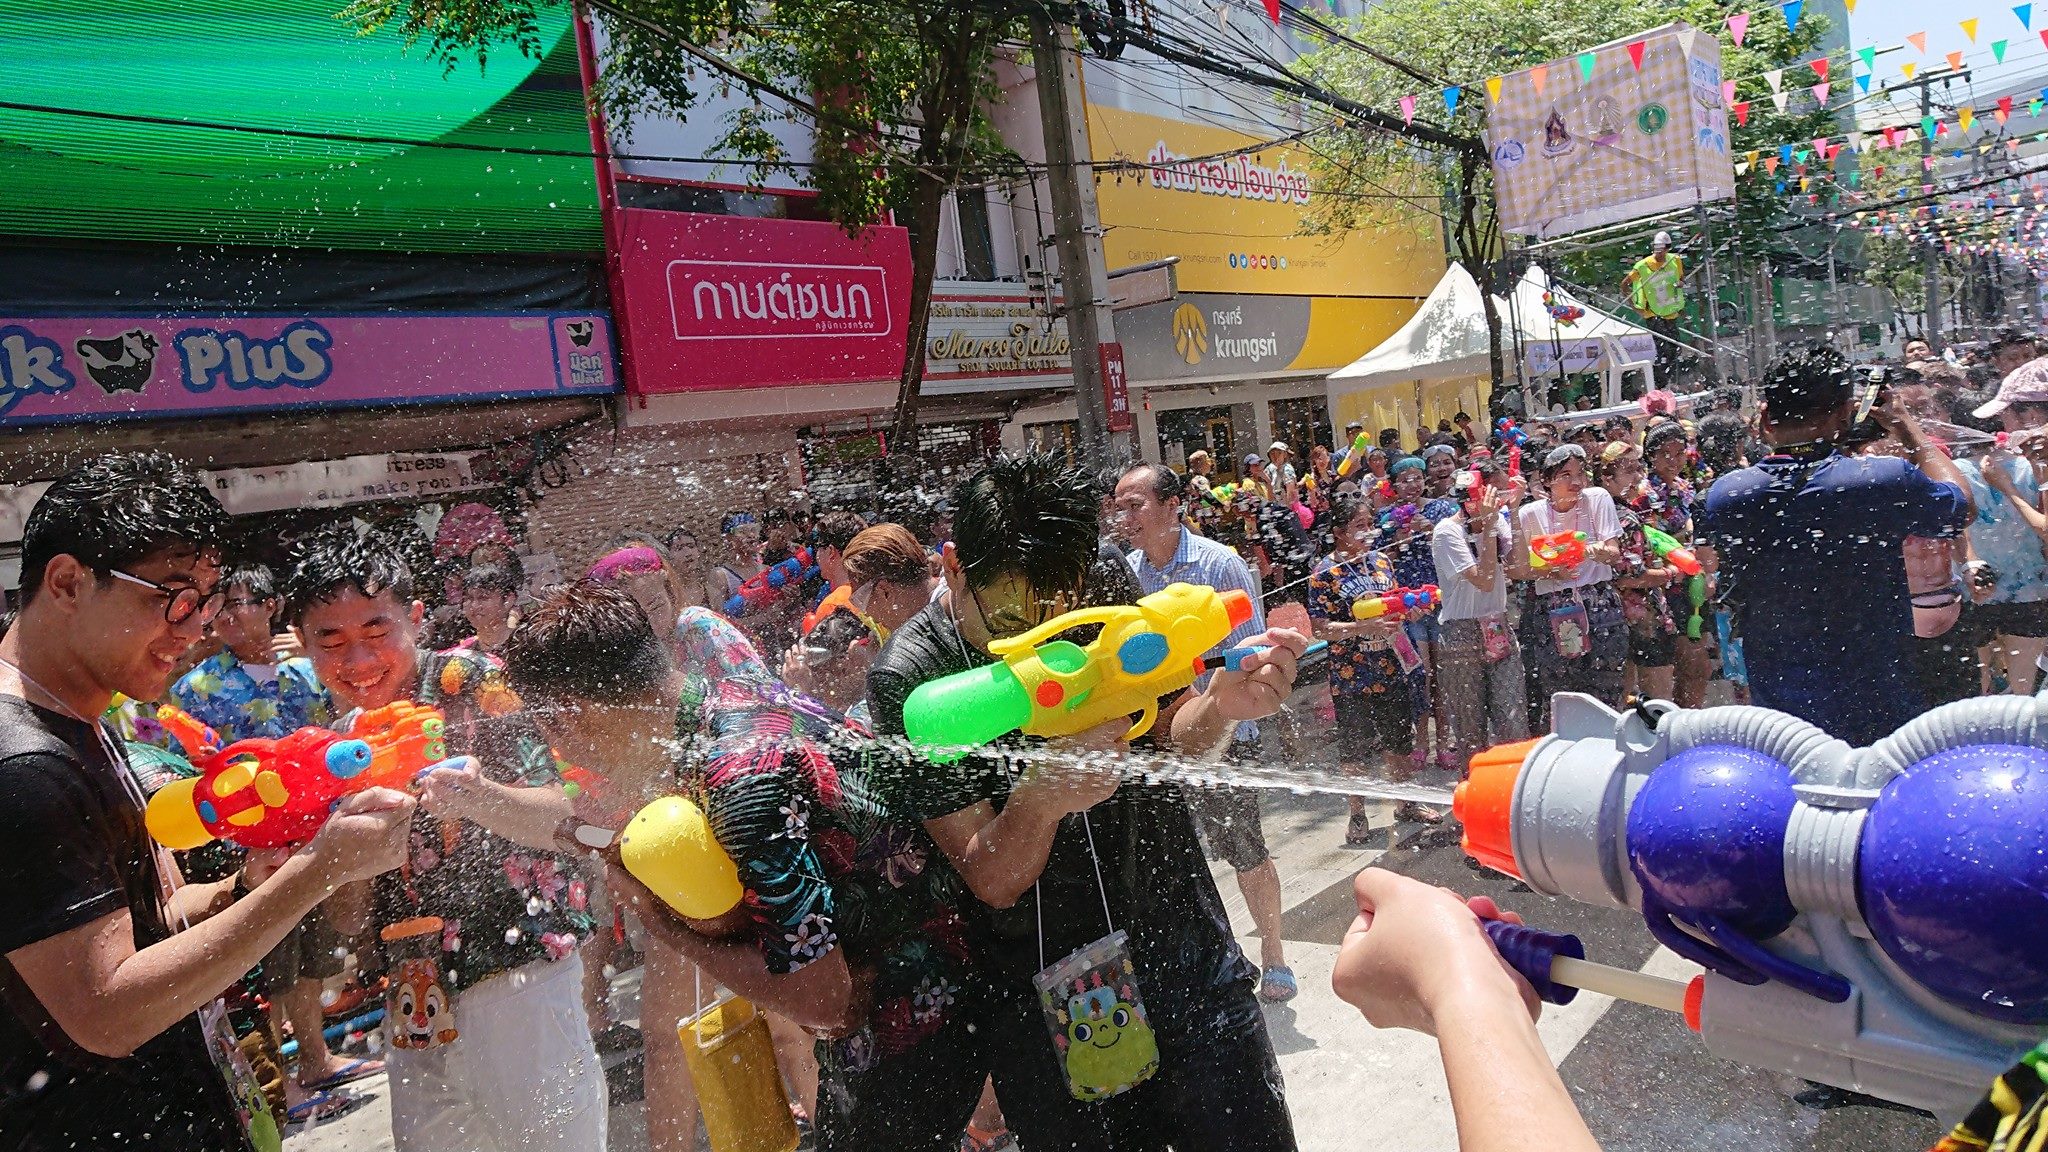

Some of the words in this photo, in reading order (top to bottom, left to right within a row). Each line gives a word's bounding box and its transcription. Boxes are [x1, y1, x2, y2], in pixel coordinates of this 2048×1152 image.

[692, 272, 872, 320] กานต์ชนก
[1212, 305, 1243, 331] กรุงศรี
[930, 328, 1008, 360] Marco
[1009, 321, 1071, 361] Tailo
[1215, 332, 1278, 363] krungsri
[1107, 361, 1123, 375] PM
[1110, 375, 1122, 389] 11
[361, 478, 411, 496] make
[417, 477, 451, 497] you
[1338, 580, 1355, 599] NEW
